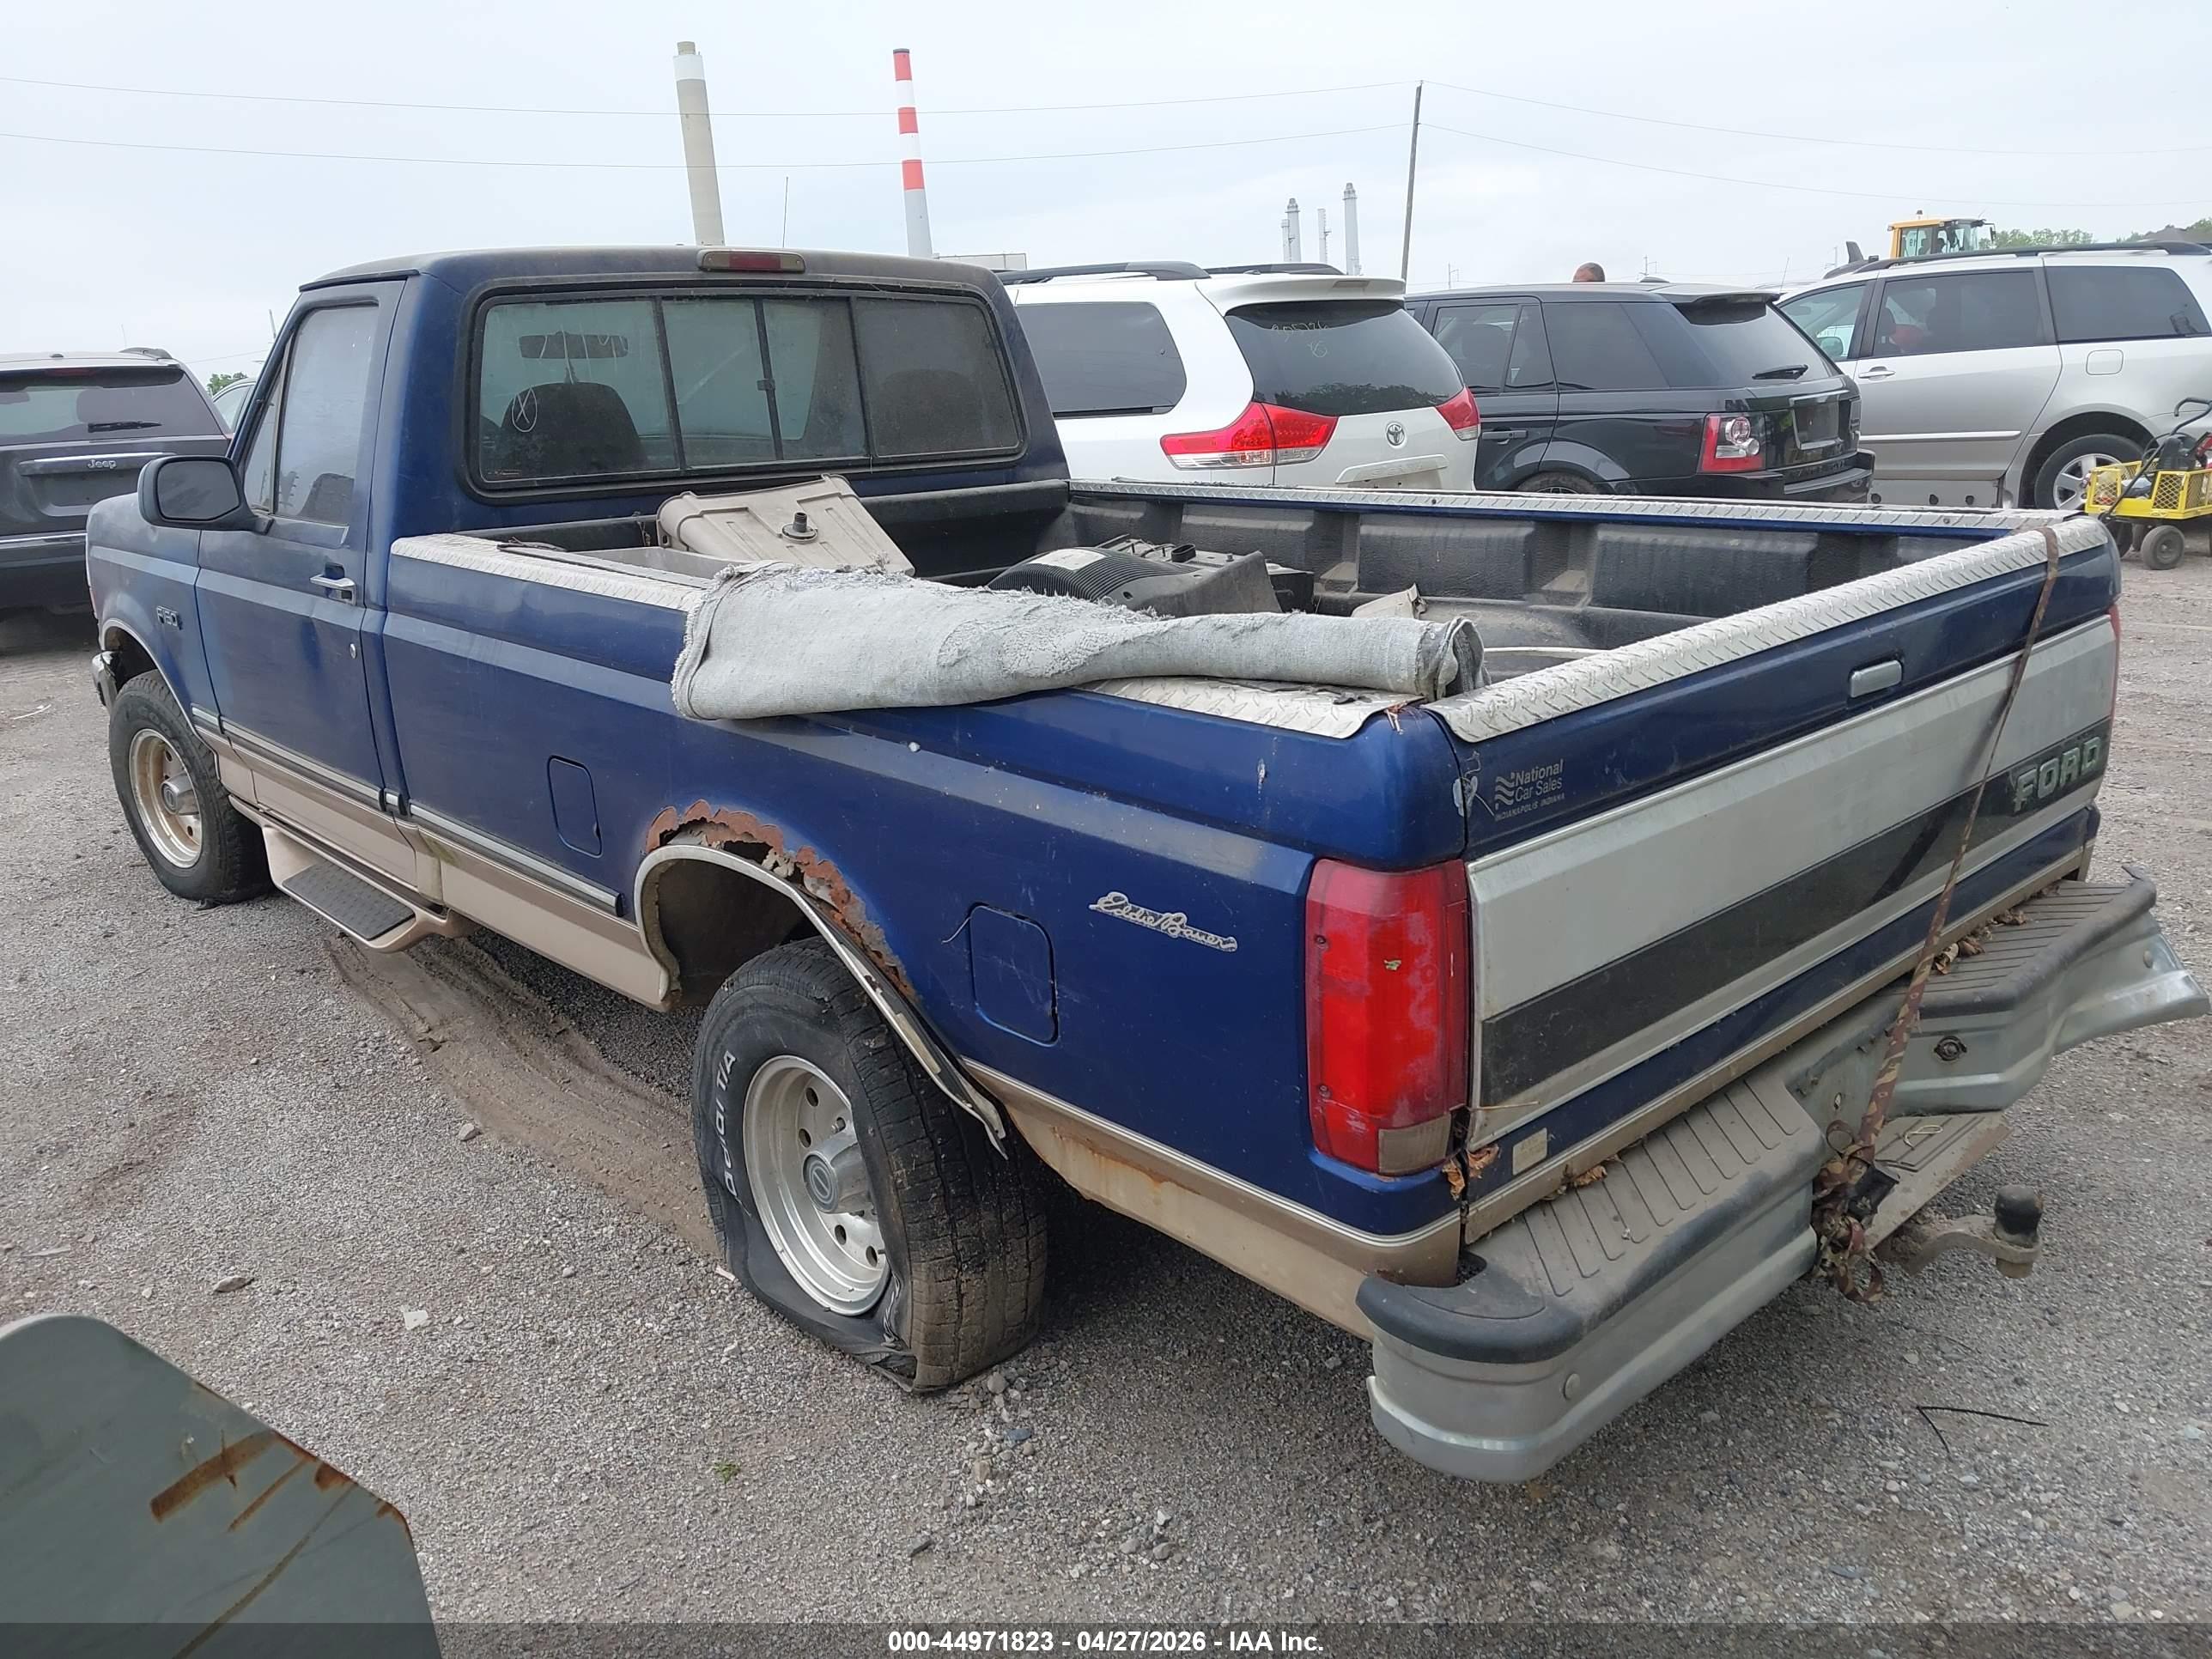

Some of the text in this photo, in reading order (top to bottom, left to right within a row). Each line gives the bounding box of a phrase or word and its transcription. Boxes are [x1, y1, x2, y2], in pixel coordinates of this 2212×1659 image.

[87, 459, 118, 470] Jeep
[1515, 758, 1564, 787] National
[1515, 777, 1563, 802] Car Sales
[2013, 736, 2101, 812] FORD
[1088, 891, 1237, 952] Eddie Bauer
[715, 1049, 741, 1204] adial T/A
